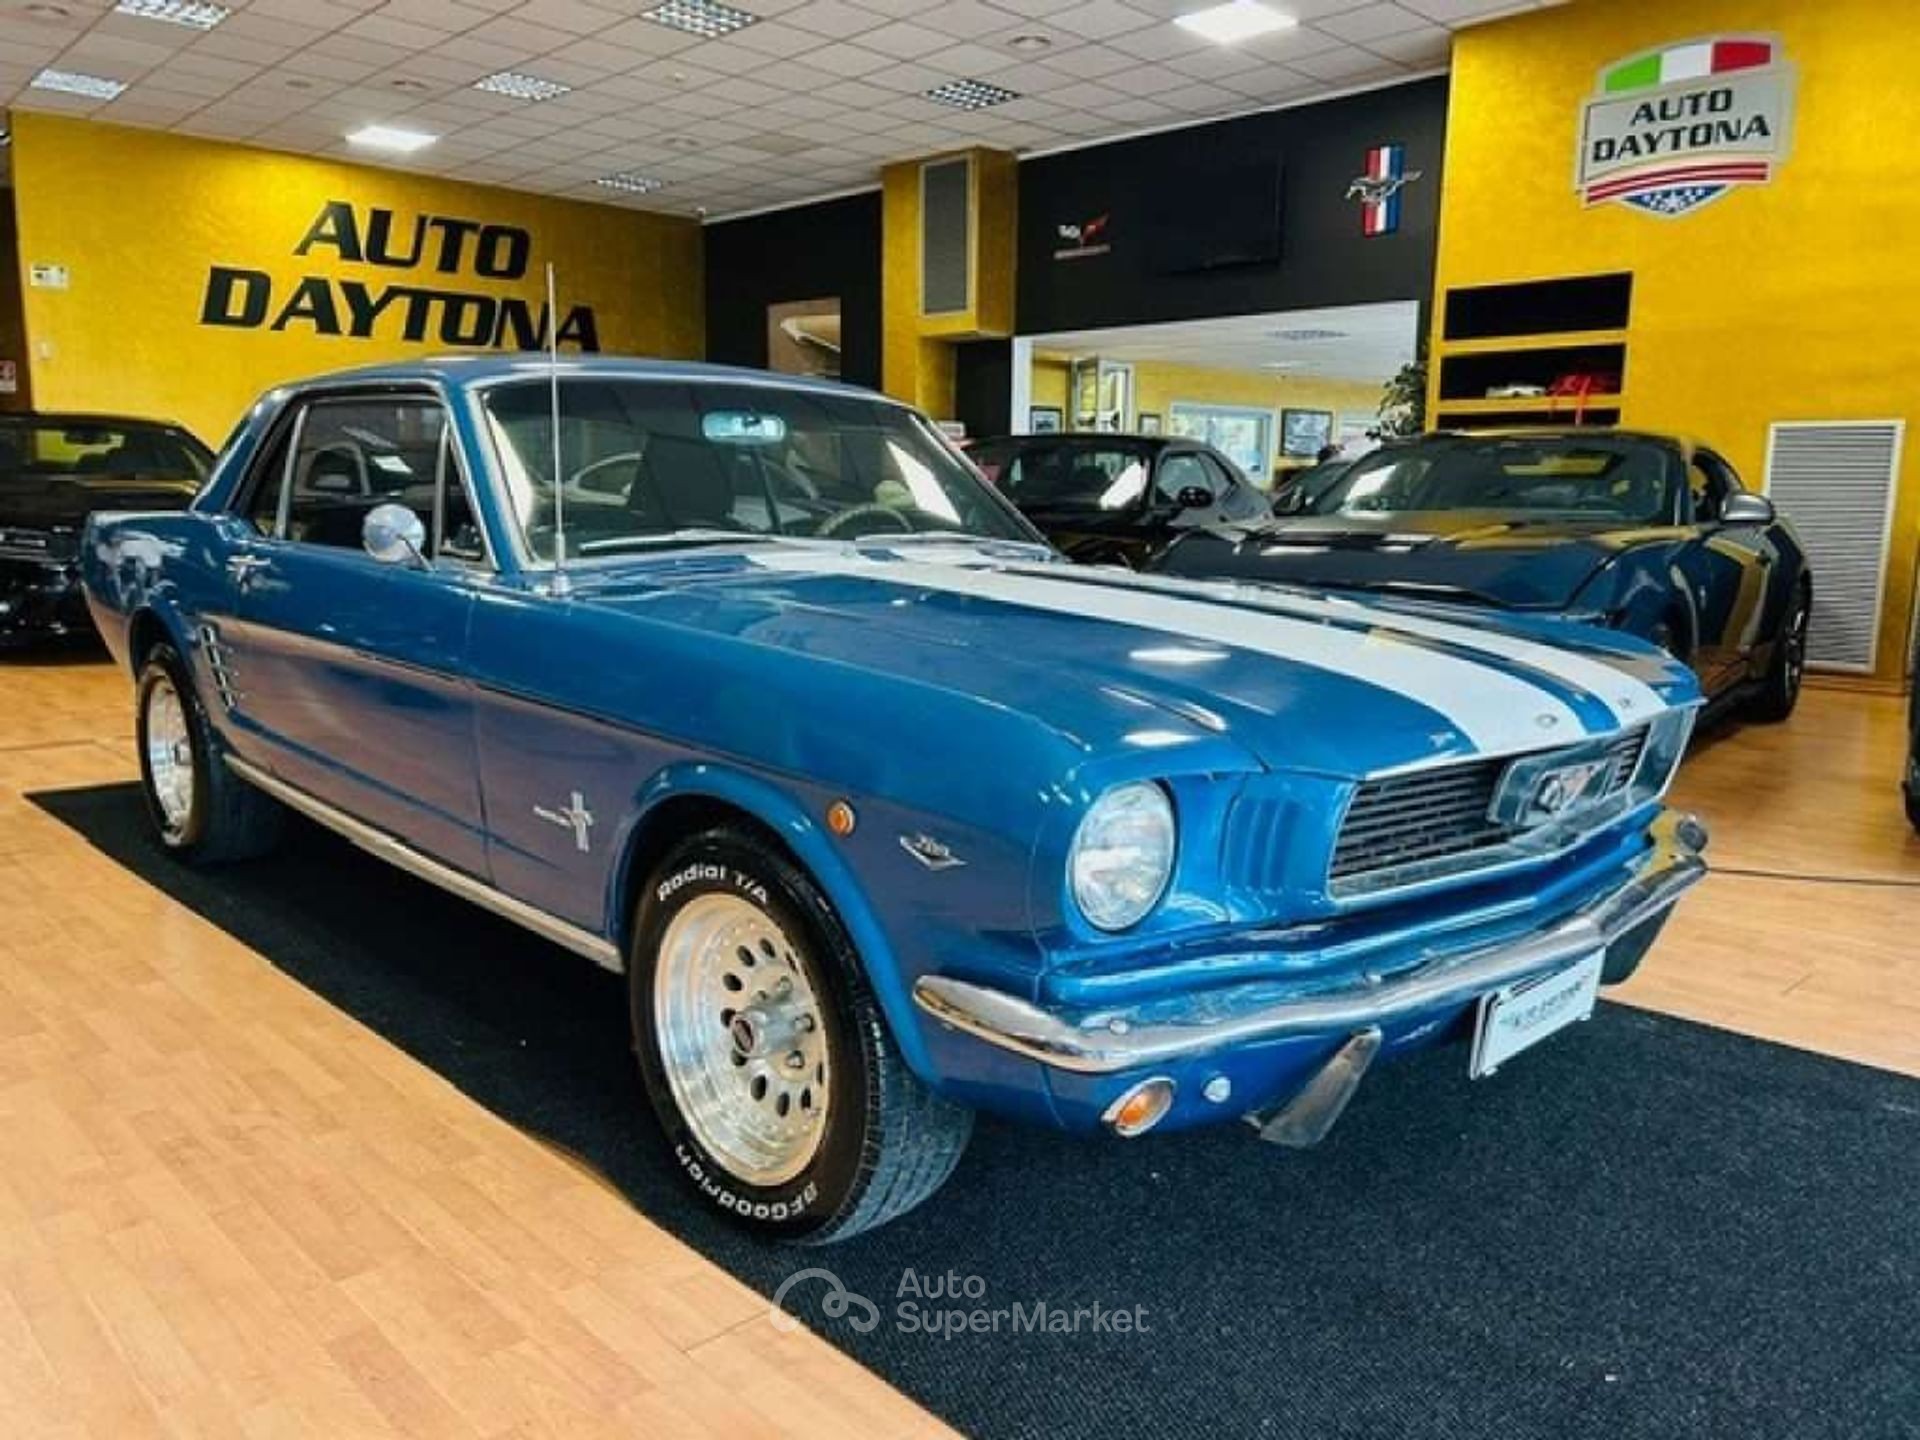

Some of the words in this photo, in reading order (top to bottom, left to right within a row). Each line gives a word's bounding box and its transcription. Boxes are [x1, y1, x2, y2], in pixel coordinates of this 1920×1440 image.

[1630, 87, 1733, 126] AUTO
[1593, 114, 1771, 162] DAYTONA
[293, 200, 530, 279] AUTO
[201, 265, 600, 352] DAYTONA
[657, 863, 727, 902] Radial
